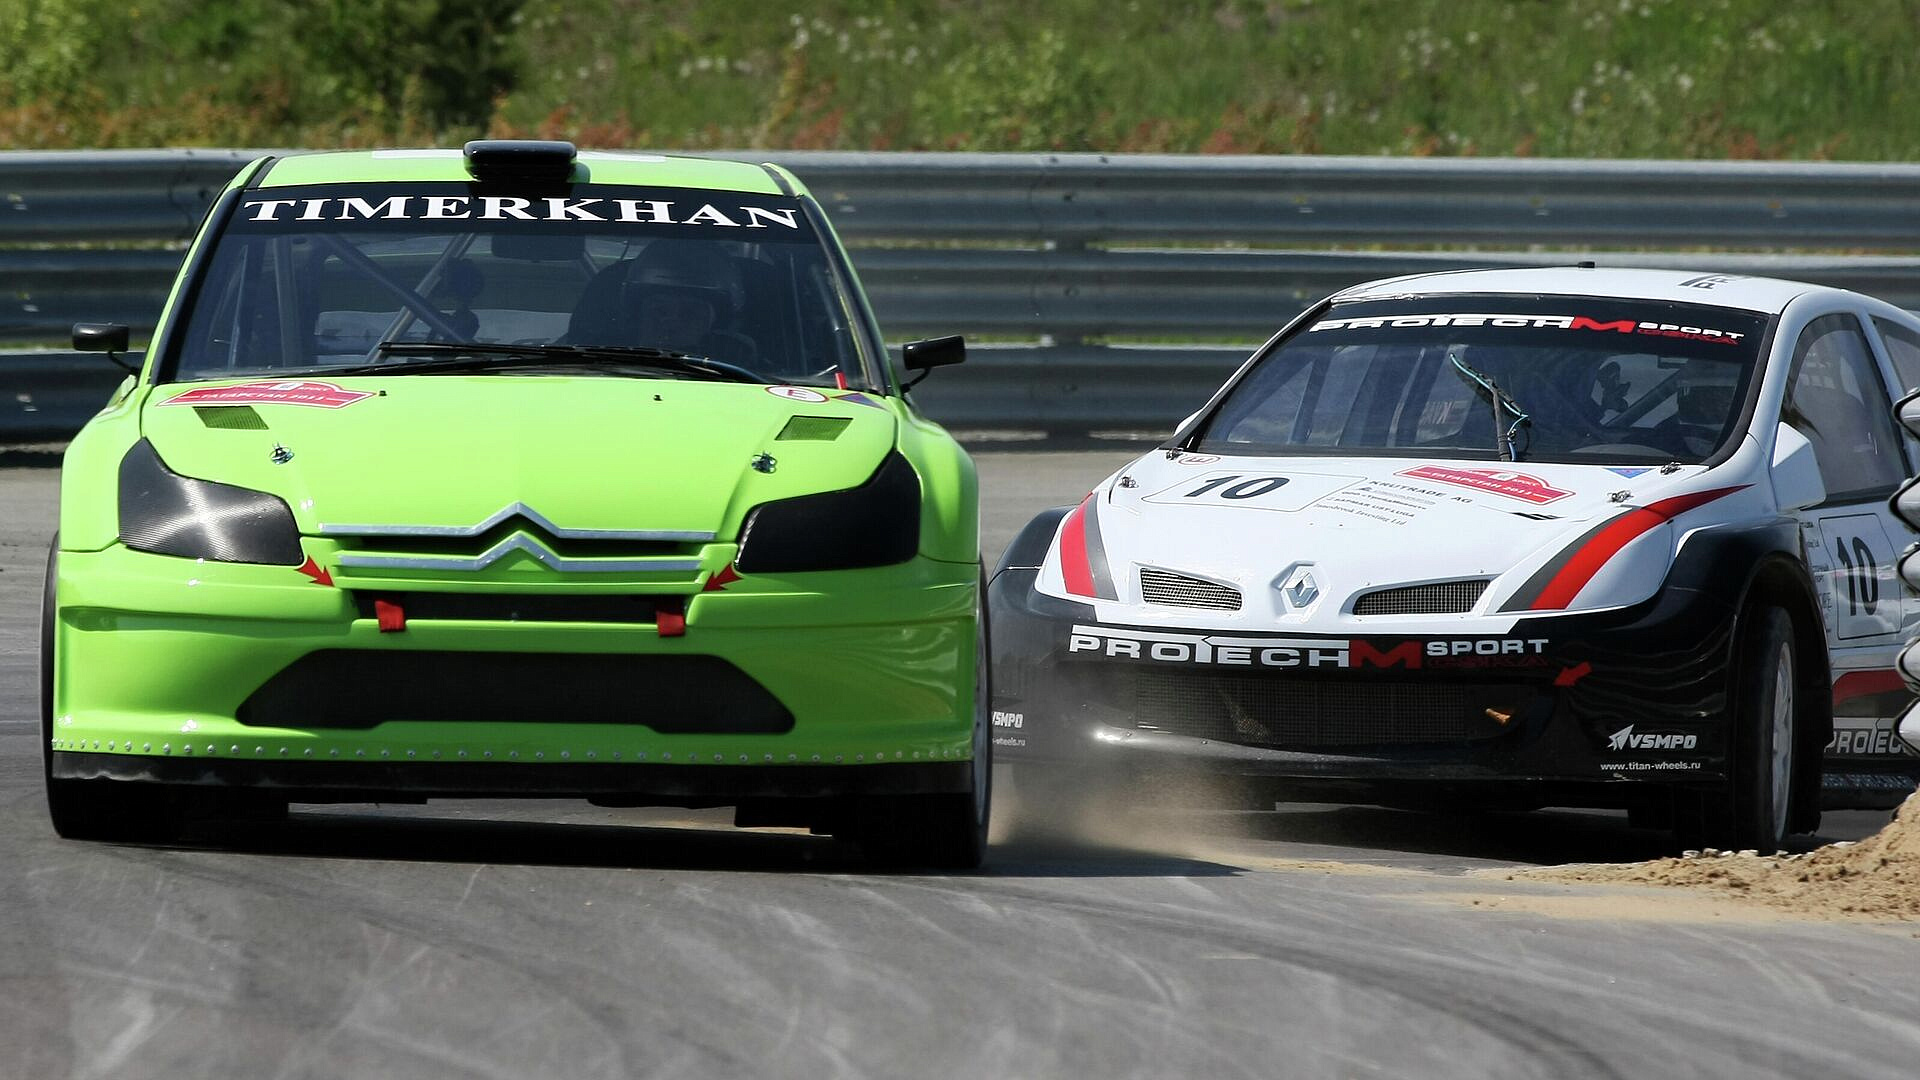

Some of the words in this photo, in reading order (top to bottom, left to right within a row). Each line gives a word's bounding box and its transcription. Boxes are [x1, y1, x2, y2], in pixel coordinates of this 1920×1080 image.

[244, 196, 799, 230] TIMERKHAN
[1638, 321, 1745, 339] SPORT
[1184, 475, 1290, 499] 10
[1836, 536, 1879, 617] 10
[1427, 639, 1549, 656] SPORT
[1629, 734, 1697, 749] VSMPO
[1600, 761, 1701, 770] www.titan-wheels.ru
